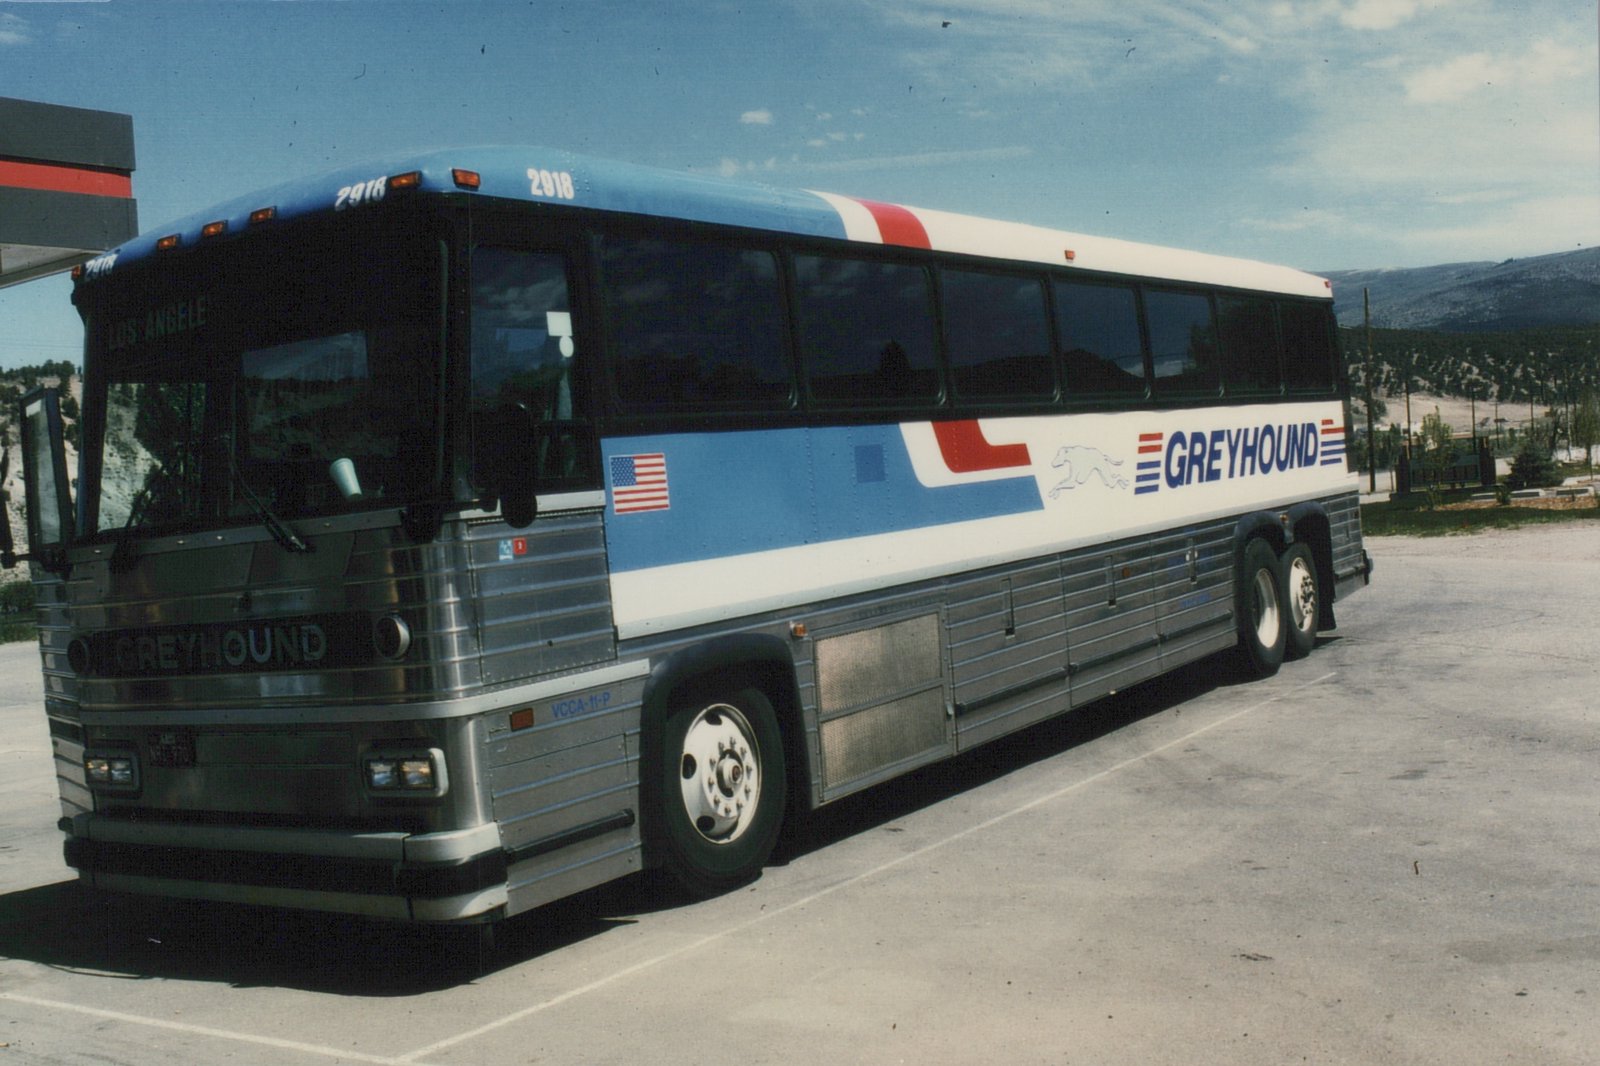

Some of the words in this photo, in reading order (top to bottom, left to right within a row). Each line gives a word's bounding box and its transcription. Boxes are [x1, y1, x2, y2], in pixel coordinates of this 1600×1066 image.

[335, 176, 387, 212] 2918
[527, 168, 574, 199] 2918
[1164, 422, 1319, 489] GREYHOUND
[115, 623, 328, 670] GREYHOUND
